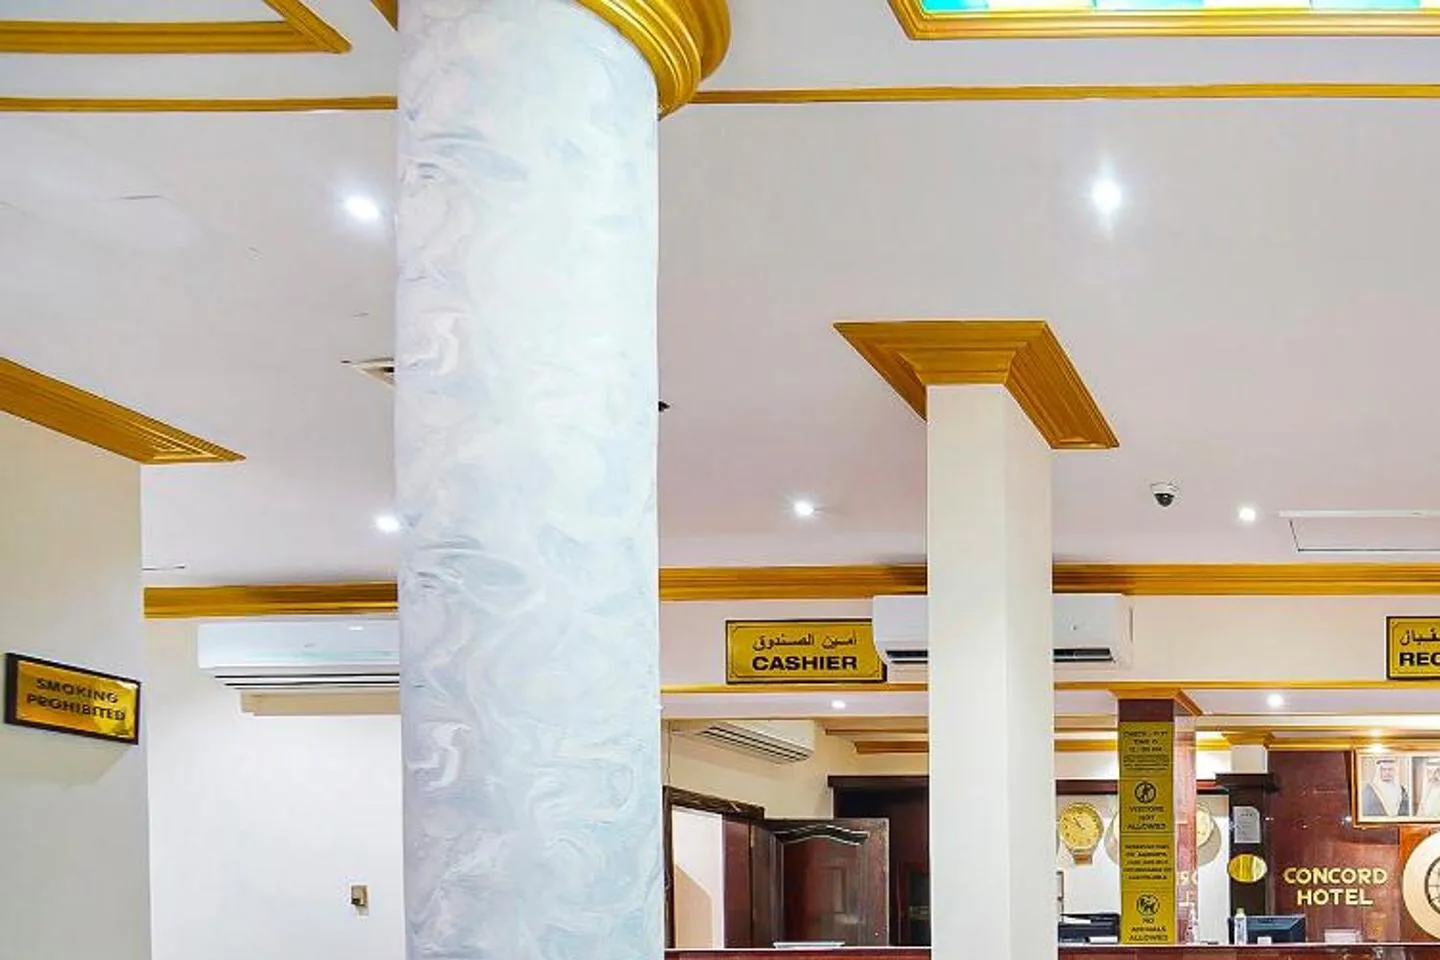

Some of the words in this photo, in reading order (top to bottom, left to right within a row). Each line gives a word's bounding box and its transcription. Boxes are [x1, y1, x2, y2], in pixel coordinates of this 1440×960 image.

[752, 632, 815, 651] الصندوق
[752, 655, 858, 671] CASHIER
[36, 678, 118, 704] SMOKING
[27, 692, 125, 721] PROHIBITED
[1283, 867, 1388, 885] CONCORD
[1297, 888, 1374, 906] HOTEL
